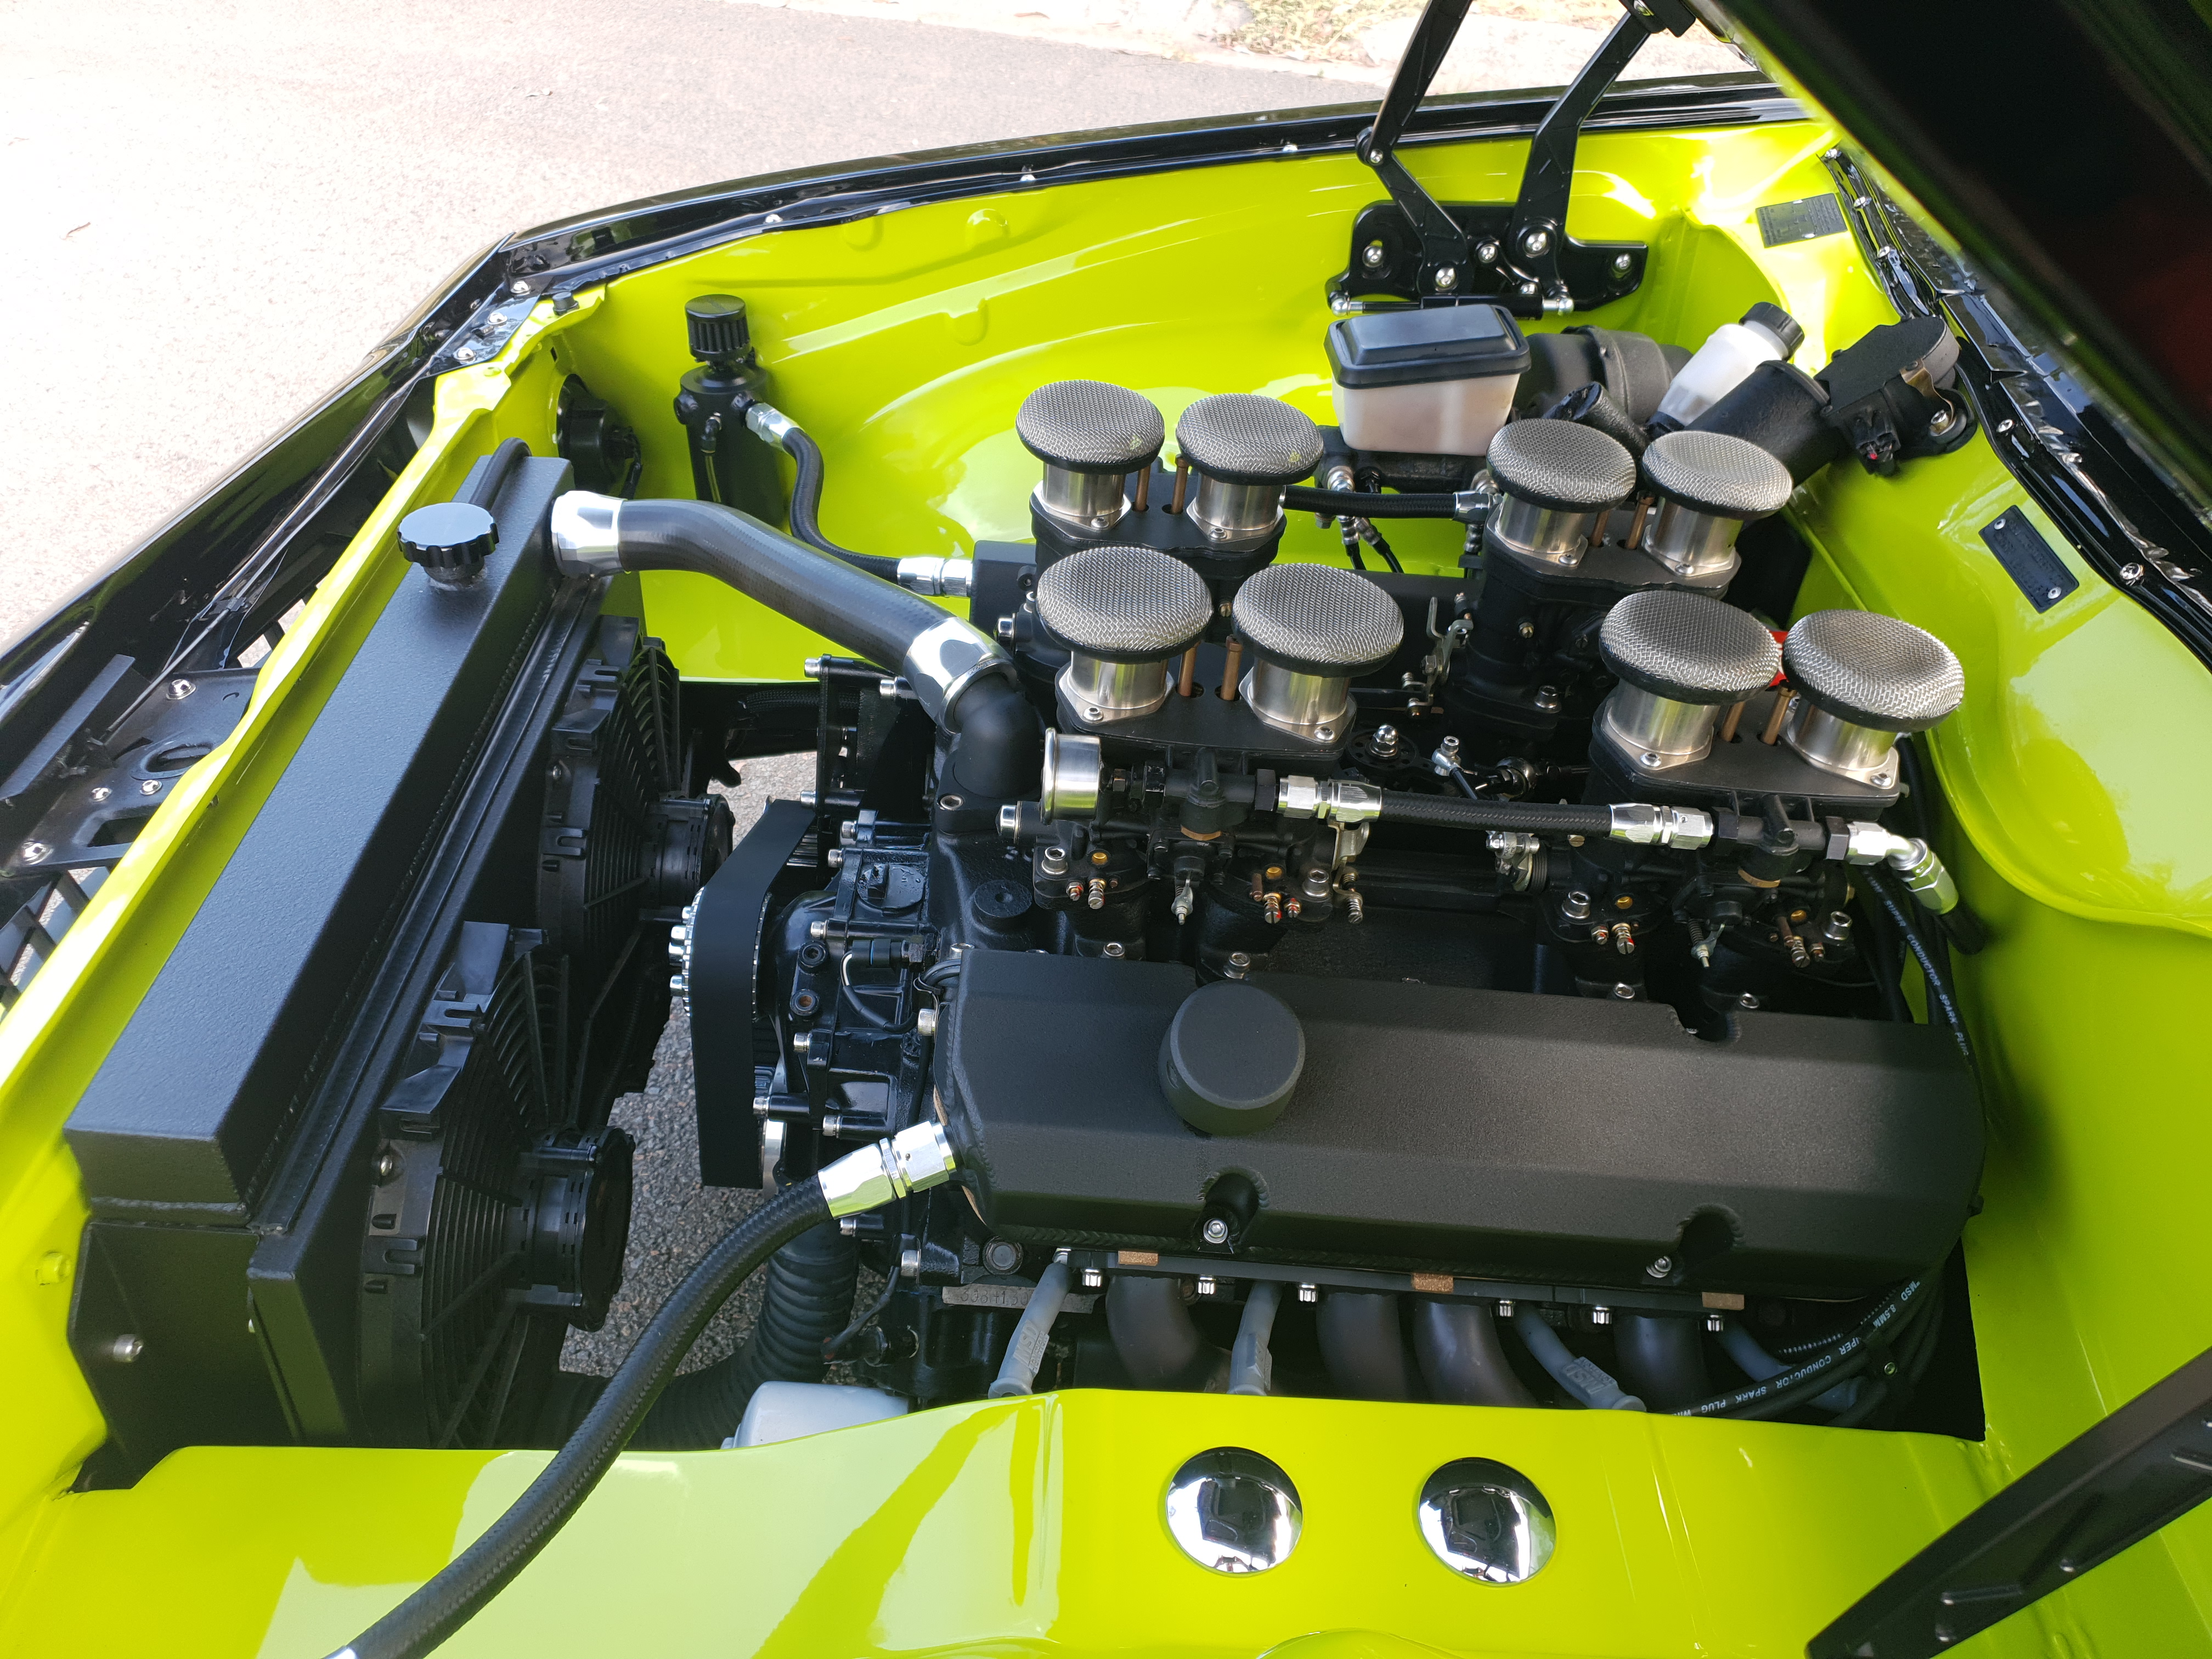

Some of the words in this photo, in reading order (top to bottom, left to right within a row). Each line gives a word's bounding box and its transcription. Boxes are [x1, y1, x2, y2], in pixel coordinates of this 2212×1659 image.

[1884, 900, 1906, 927] SUPER
[1906, 934, 1941, 986] CONDUCTOR
[1939, 994, 1958, 1024] SPARK
[1013, 1319, 1039, 1367] MSD
[1701, 1399, 1726, 1413] PLUG
[1735, 1386, 1767, 1403] SPARK
